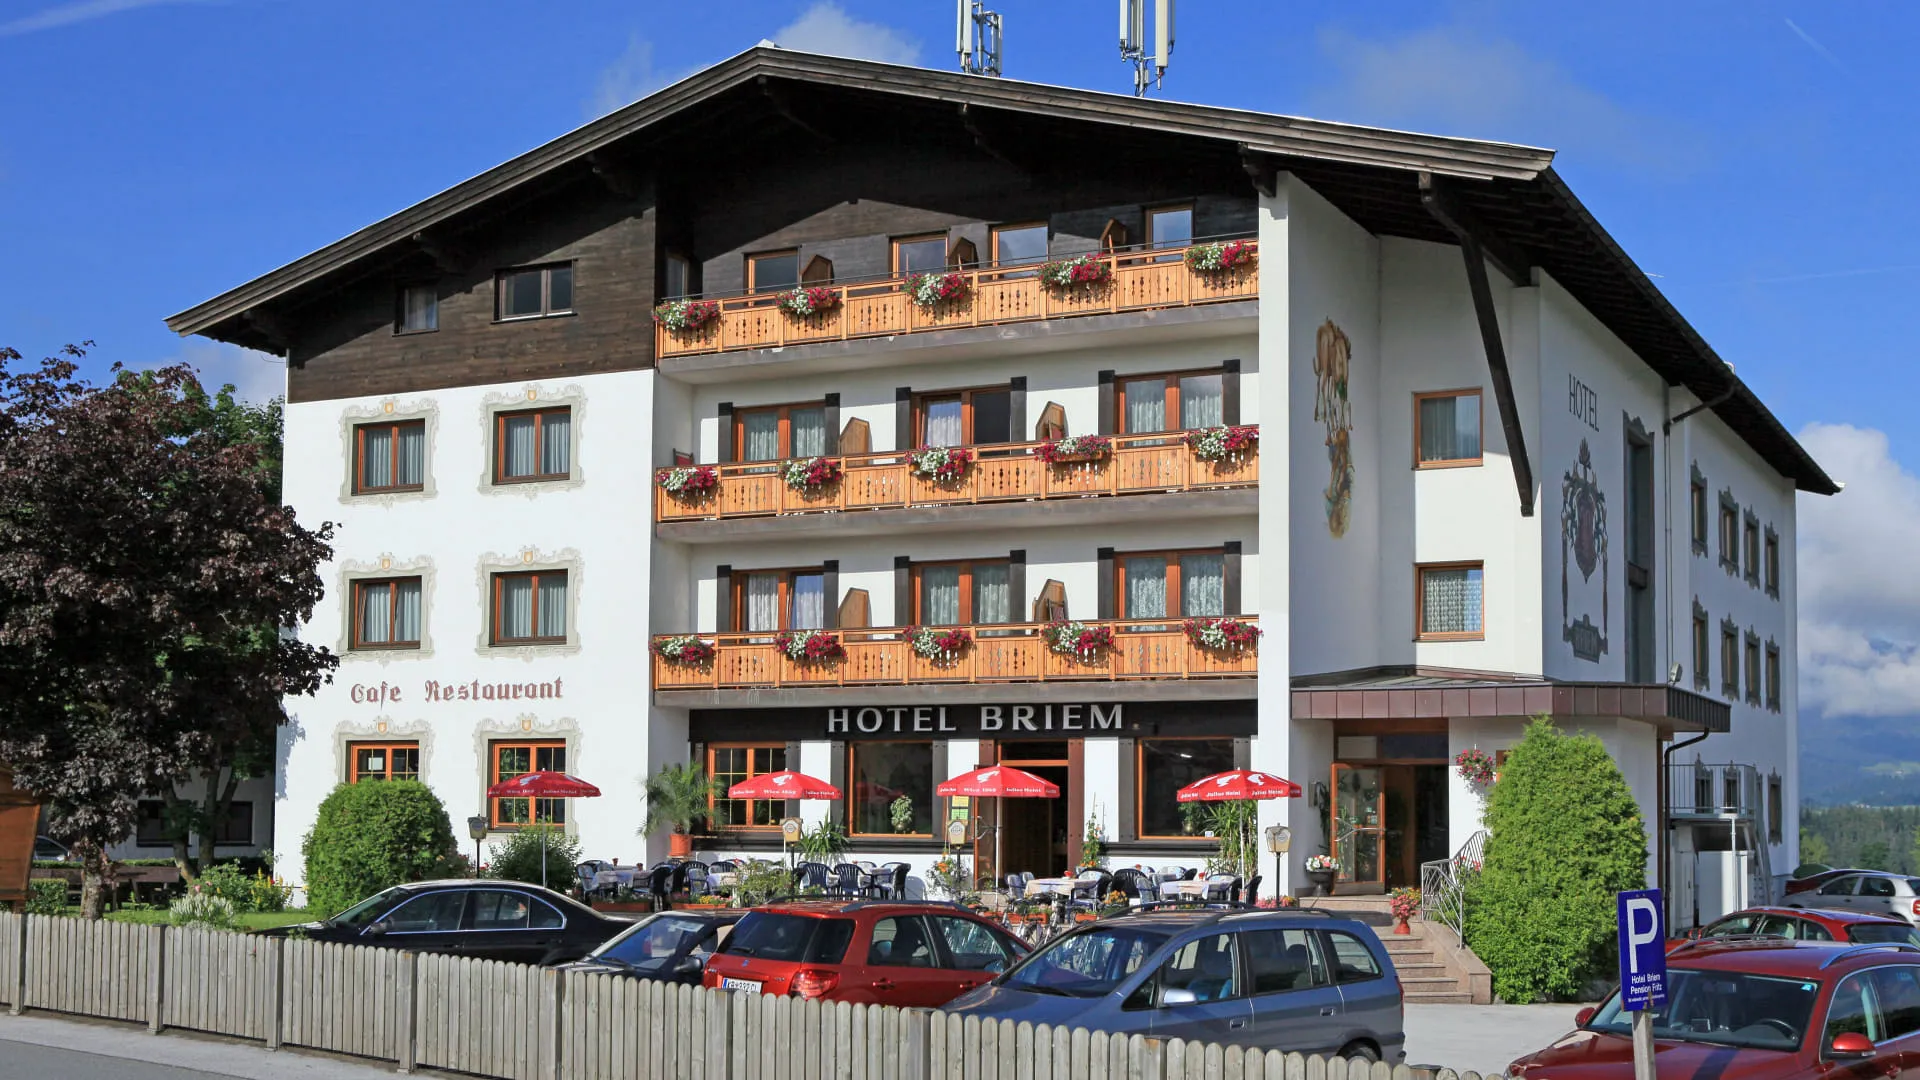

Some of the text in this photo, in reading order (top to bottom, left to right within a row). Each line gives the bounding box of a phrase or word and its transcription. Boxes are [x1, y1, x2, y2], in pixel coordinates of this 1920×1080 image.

[1569, 372, 1600, 433] HOTEL
[350, 676, 564, 710] Cafe Restaurant
[828, 703, 1123, 733] HOTEL BRIEM
[1626, 898, 1658, 974] P
[1630, 985, 1652, 995] Pension
[1631, 974, 1646, 984] Hotel
